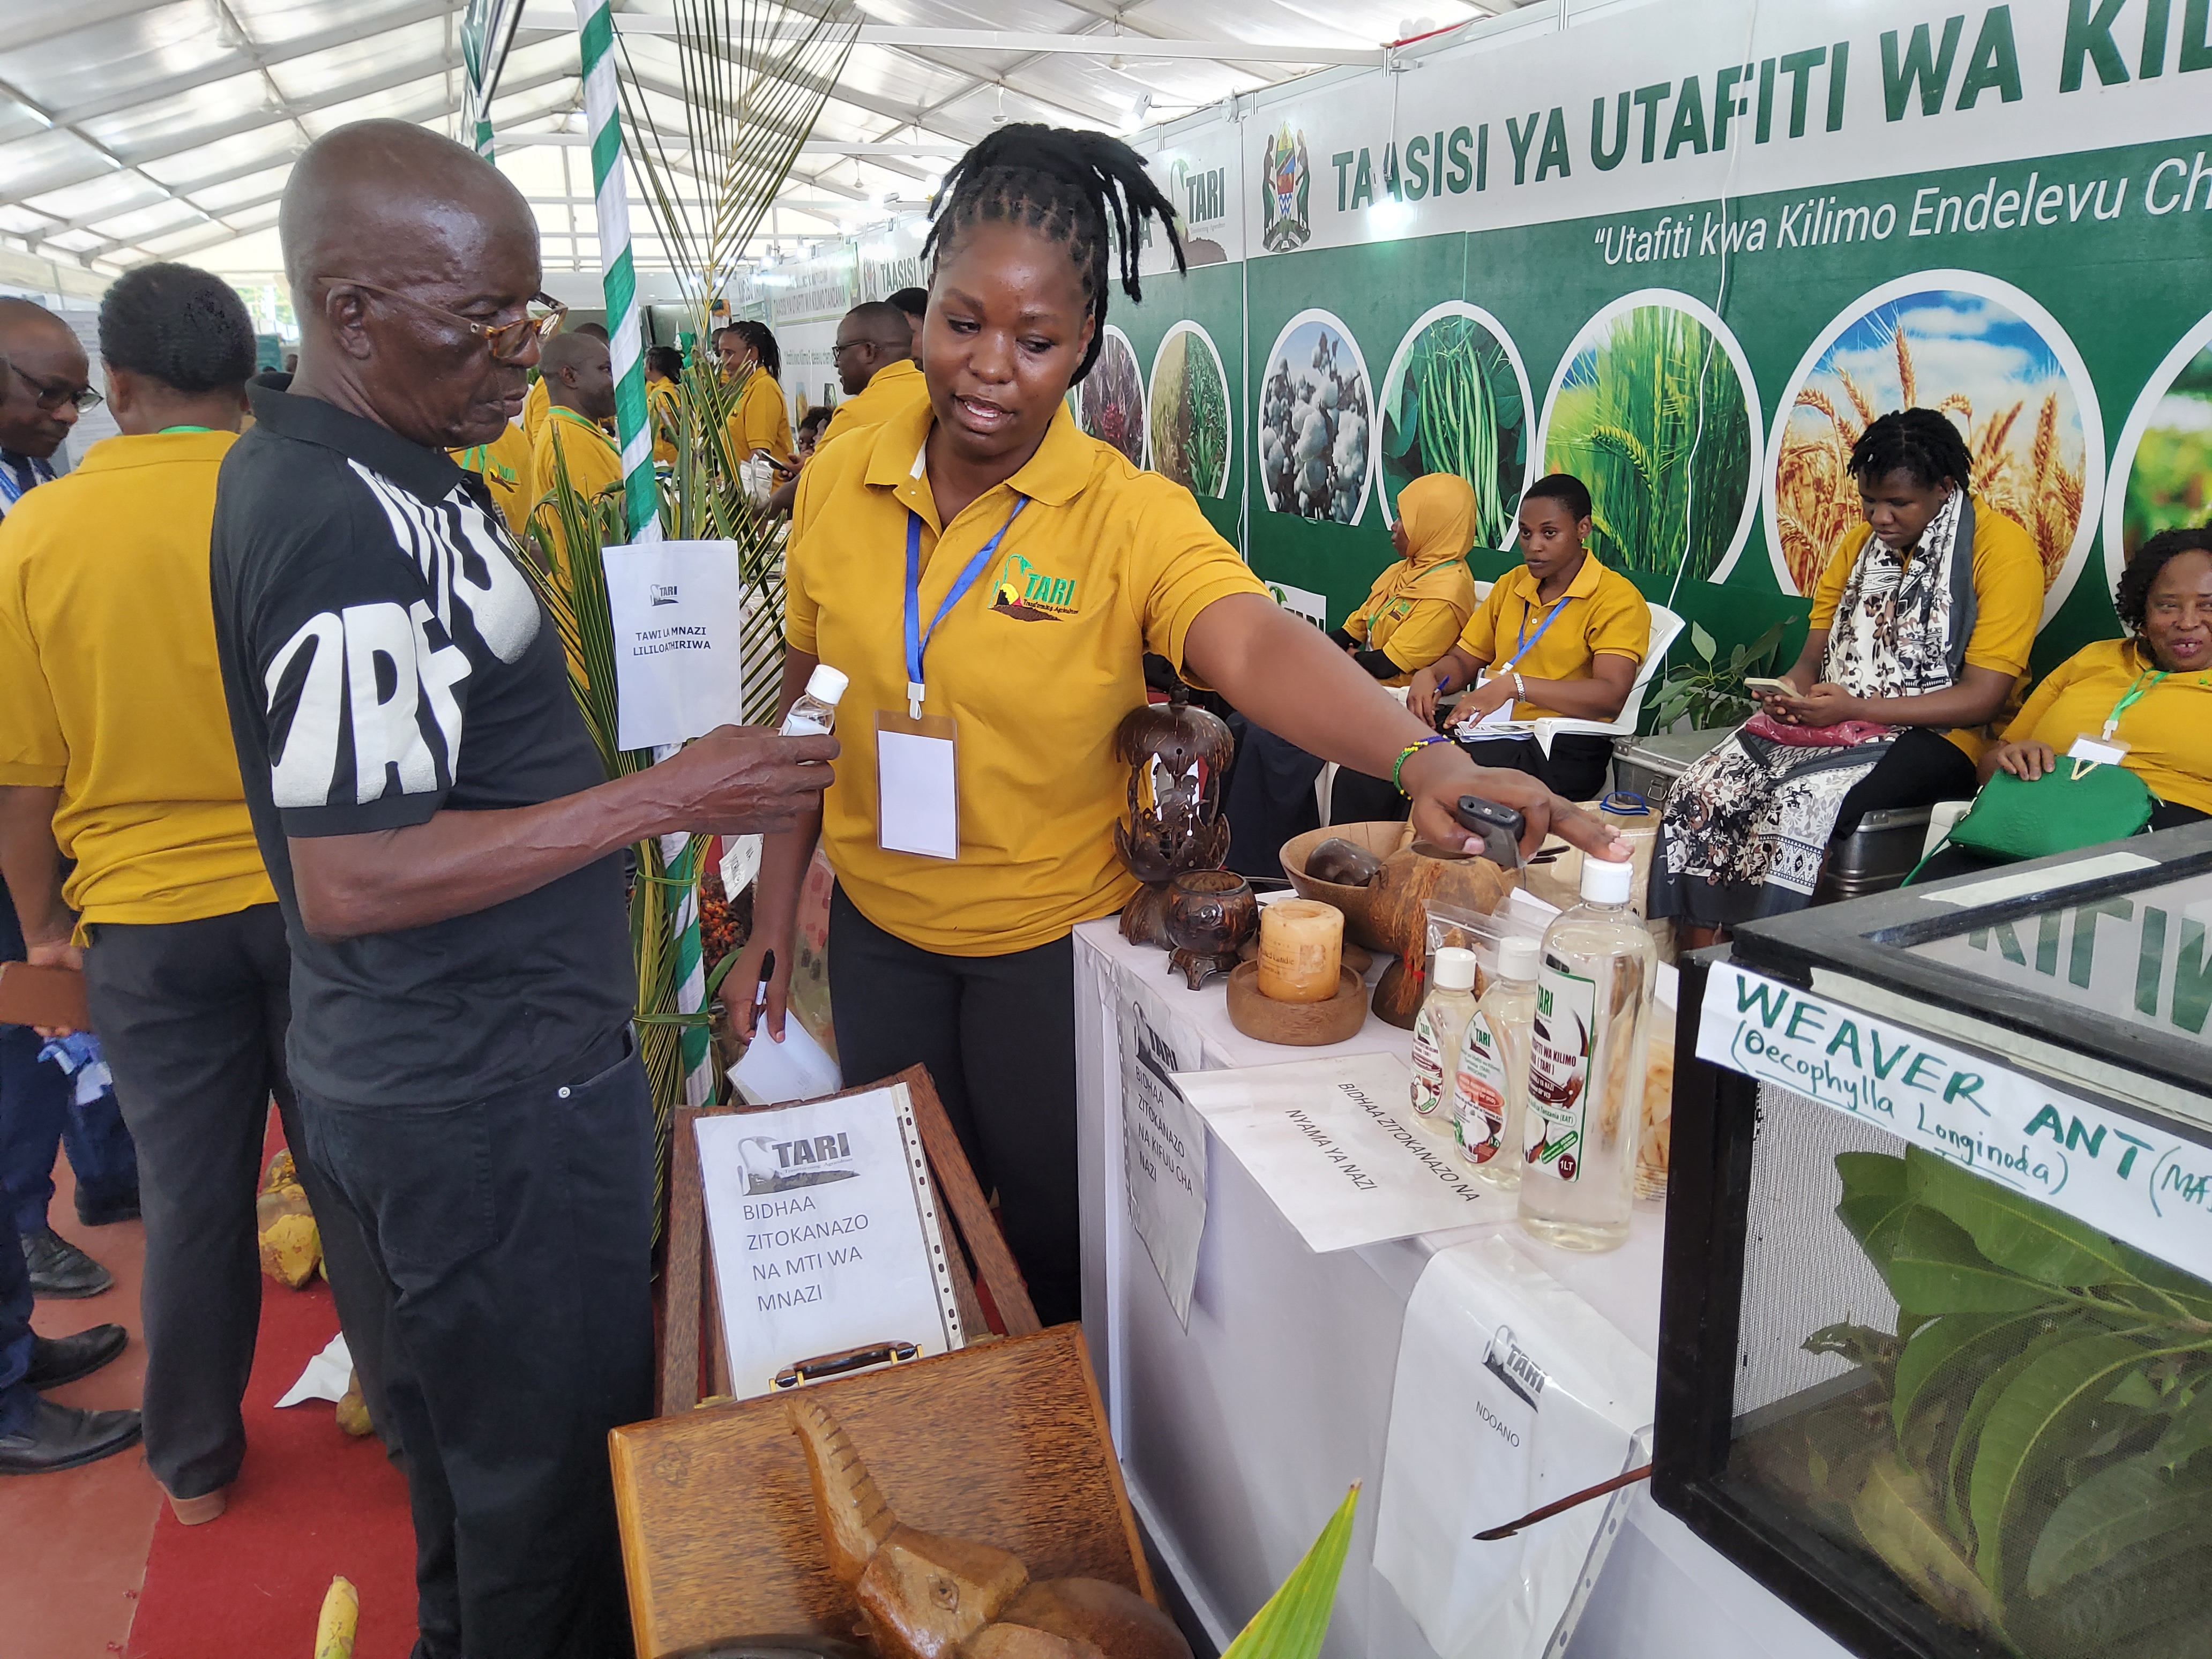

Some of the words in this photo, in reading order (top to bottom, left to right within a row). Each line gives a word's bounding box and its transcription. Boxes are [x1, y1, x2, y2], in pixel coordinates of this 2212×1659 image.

[1332, 123, 1489, 213] TAASISI
[1506, 107, 1571, 185] YA
[1590, 41, 1849, 172] UTAFITI
[1880, 5, 2023, 122] WA
[1186, 167, 1224, 224] TARI
[1700, 217, 1765, 256] kwa
[1777, 198, 1896, 249] Kilimo
[1908, 171, 2129, 237] Endelevu
[2144, 151, 2212, 215] Ch
[880, 256, 917, 292] TAASISI
[660, 586, 677, 597] TARI
[1024, 573, 1076, 606] TARI
[633, 640, 711, 656] LILILOATHIRIWA
[636, 630, 661, 641] TAWI
[663, 628, 670, 638] LA
[671, 626, 706, 636] MNAZI
[1146, 1023, 1178, 1071] TARI
[1475, 1027, 1491, 1048] TARI
[1543, 1046, 1552, 1059] WA
[1553, 1050, 1576, 1067] KILIMO
[1135, 1065, 1164, 1108] BIDHAA
[1736, 974, 1991, 1117] WEAVER
[2023, 1103, 2155, 1180] ANT
[1138, 1093, 1184, 1158] ZITOKANAZO
[1560, 1114, 1573, 1124] (EAT)
[772, 1132, 850, 1168] TARI
[1139, 1122, 1150, 1147] NA
[1152, 1136, 1174, 1173] KIFUU
[1176, 1165, 1193, 1197] CHA
[1286, 1110, 1332, 1148] NYAMA
[1325, 1148, 1348, 1164] YA
[1339, 1164, 1378, 1191] NAZI
[1338, 1083, 1385, 1118] BIDHAA
[1377, 1119, 1459, 1184] ZITOKANAZO
[1451, 1184, 1480, 1202] NA
[1140, 1150, 1156, 1183] NAZI
[1560, 1160, 1574, 1171] 1LT
[743, 1195, 816, 1221] BIDHAA
[747, 1214, 869, 1251] ZITOKANAZO
[753, 1264, 781, 1281] NA
[786, 1253, 823, 1276] MTI
[827, 1246, 863, 1267] WA
[758, 1284, 823, 1311] MNAZI
[1476, 1401, 1520, 1447] NDOANO
